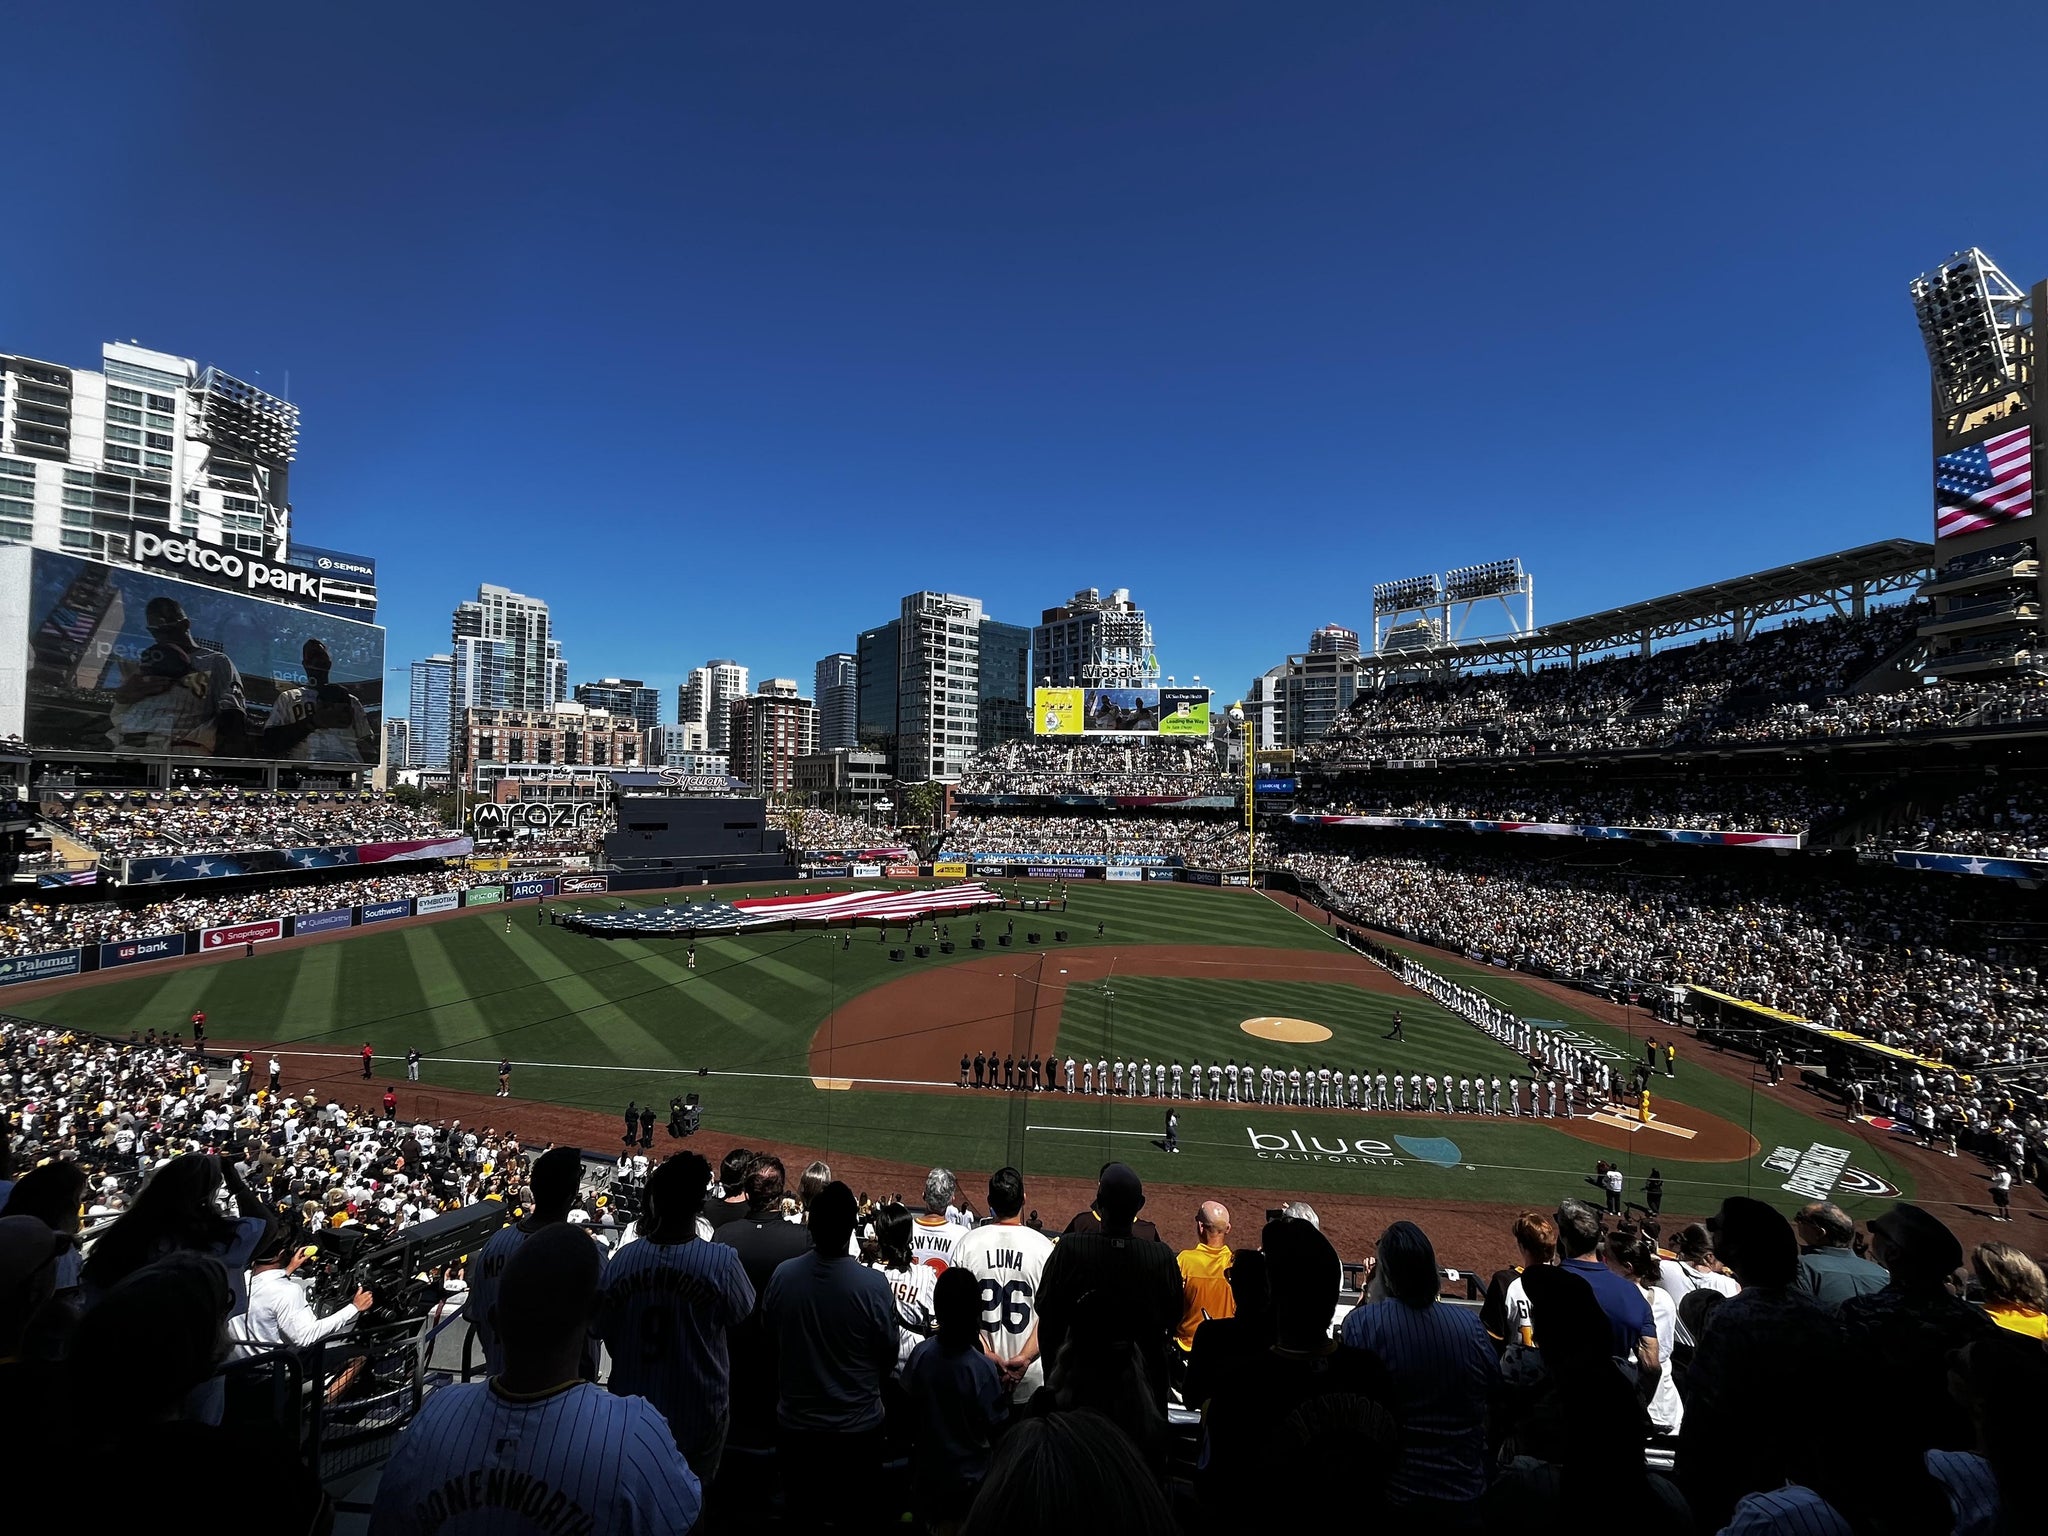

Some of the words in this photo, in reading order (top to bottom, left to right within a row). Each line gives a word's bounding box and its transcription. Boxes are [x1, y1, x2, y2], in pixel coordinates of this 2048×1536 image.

[134, 530, 242, 577] petco
[248, 560, 319, 599] park
[334, 561, 373, 575] SEMPRA
[97, 641, 164, 662] petco
[1085, 665, 1136, 678] Viasat
[658, 766, 728, 791] Sycuan
[507, 803, 593, 829] razr
[515, 884, 543, 896] ARCO
[564, 879, 602, 890] Sycuan
[364, 905, 403, 919] Southwest
[227, 926, 274, 941] Snapdragon
[120, 947, 135, 957] us
[137, 941, 168, 954] bank
[16, 955, 76, 972] Palomar
[1246, 1127, 1394, 1157] blue
[1257, 1151, 1404, 1166] CALIFORNIA
[986, 1249, 1023, 1272] LUNA
[890, 1282, 919, 1304] ISH
[980, 1278, 1033, 1334] 26
